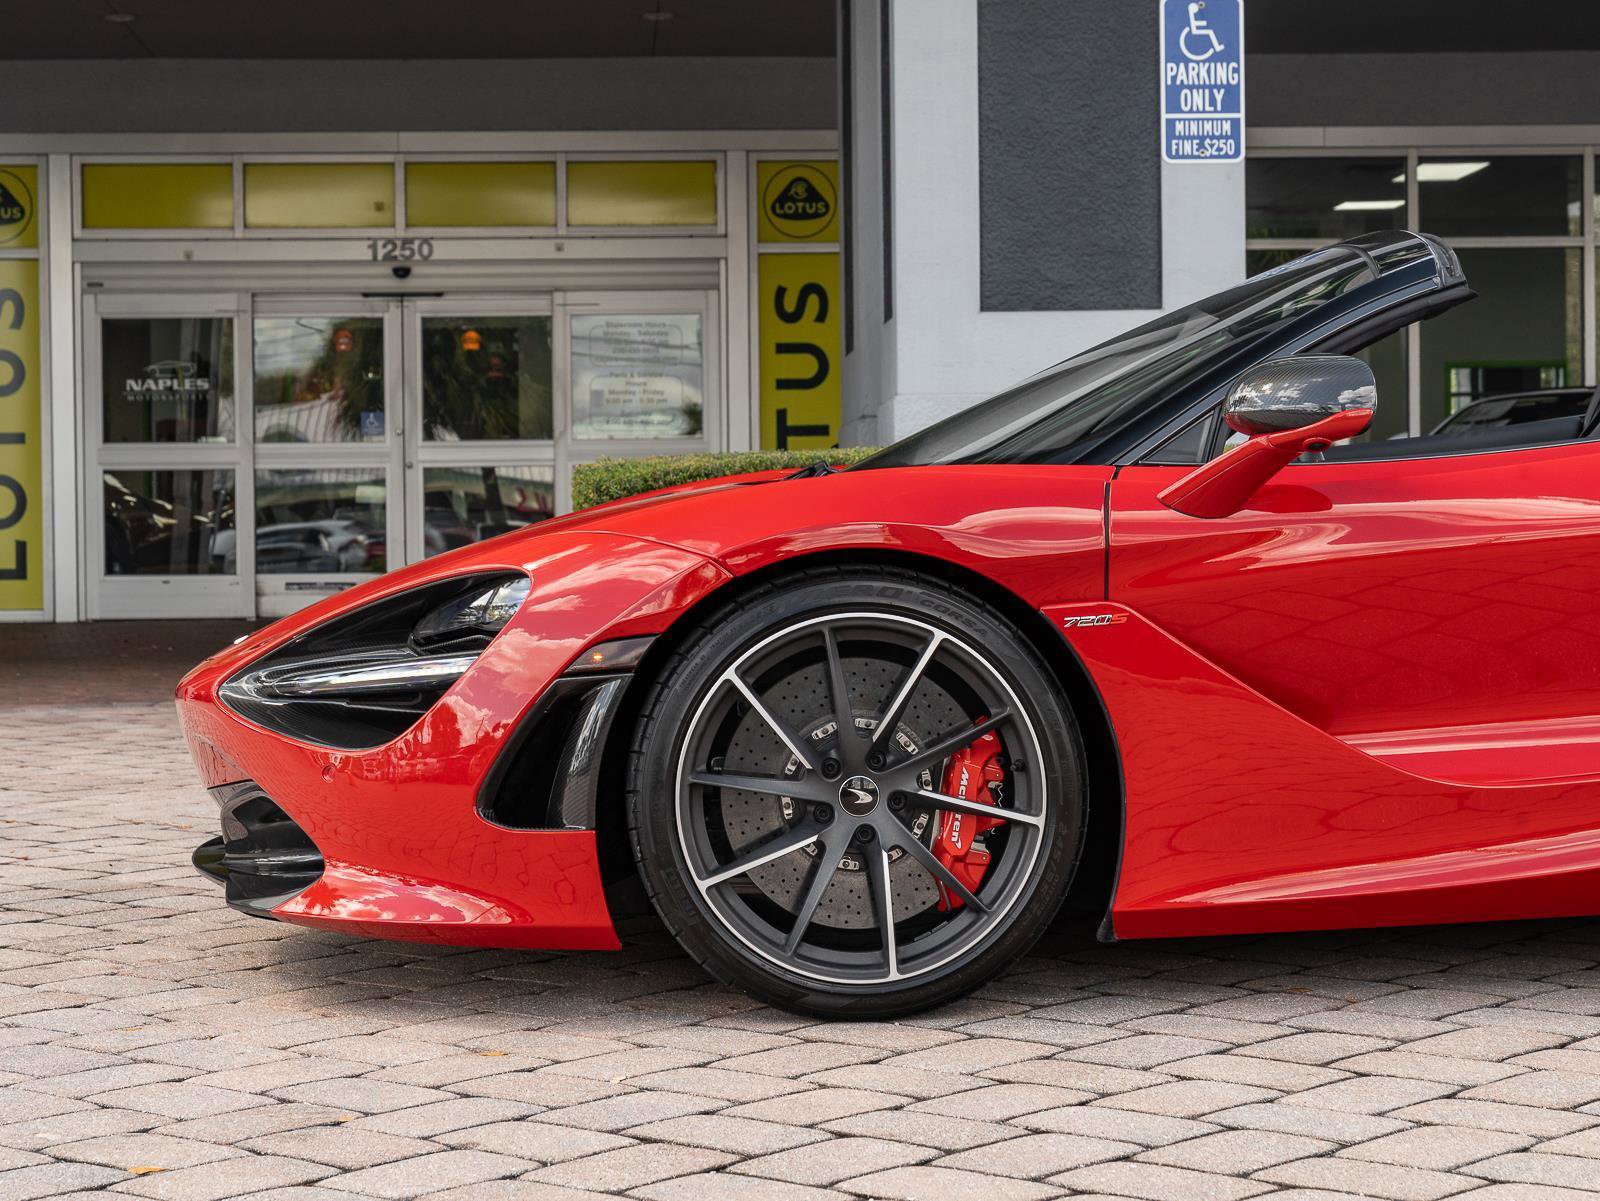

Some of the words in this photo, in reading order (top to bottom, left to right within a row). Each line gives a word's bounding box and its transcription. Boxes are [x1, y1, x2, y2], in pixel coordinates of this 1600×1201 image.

[1166, 62, 1239, 86] PARKING
[1180, 88, 1225, 112] ONLY
[1175, 119, 1232, 137] MINIMUM
[1171, 139, 1200, 156] FINE
[1204, 137, 1235, 157] $250
[775, 202, 827, 214] LOTUS
[367, 239, 434, 261] 1250
[125, 378, 210, 391] NAPLES
[1063, 612, 1130, 628] 720S
[951, 766, 969, 843] Mcren
